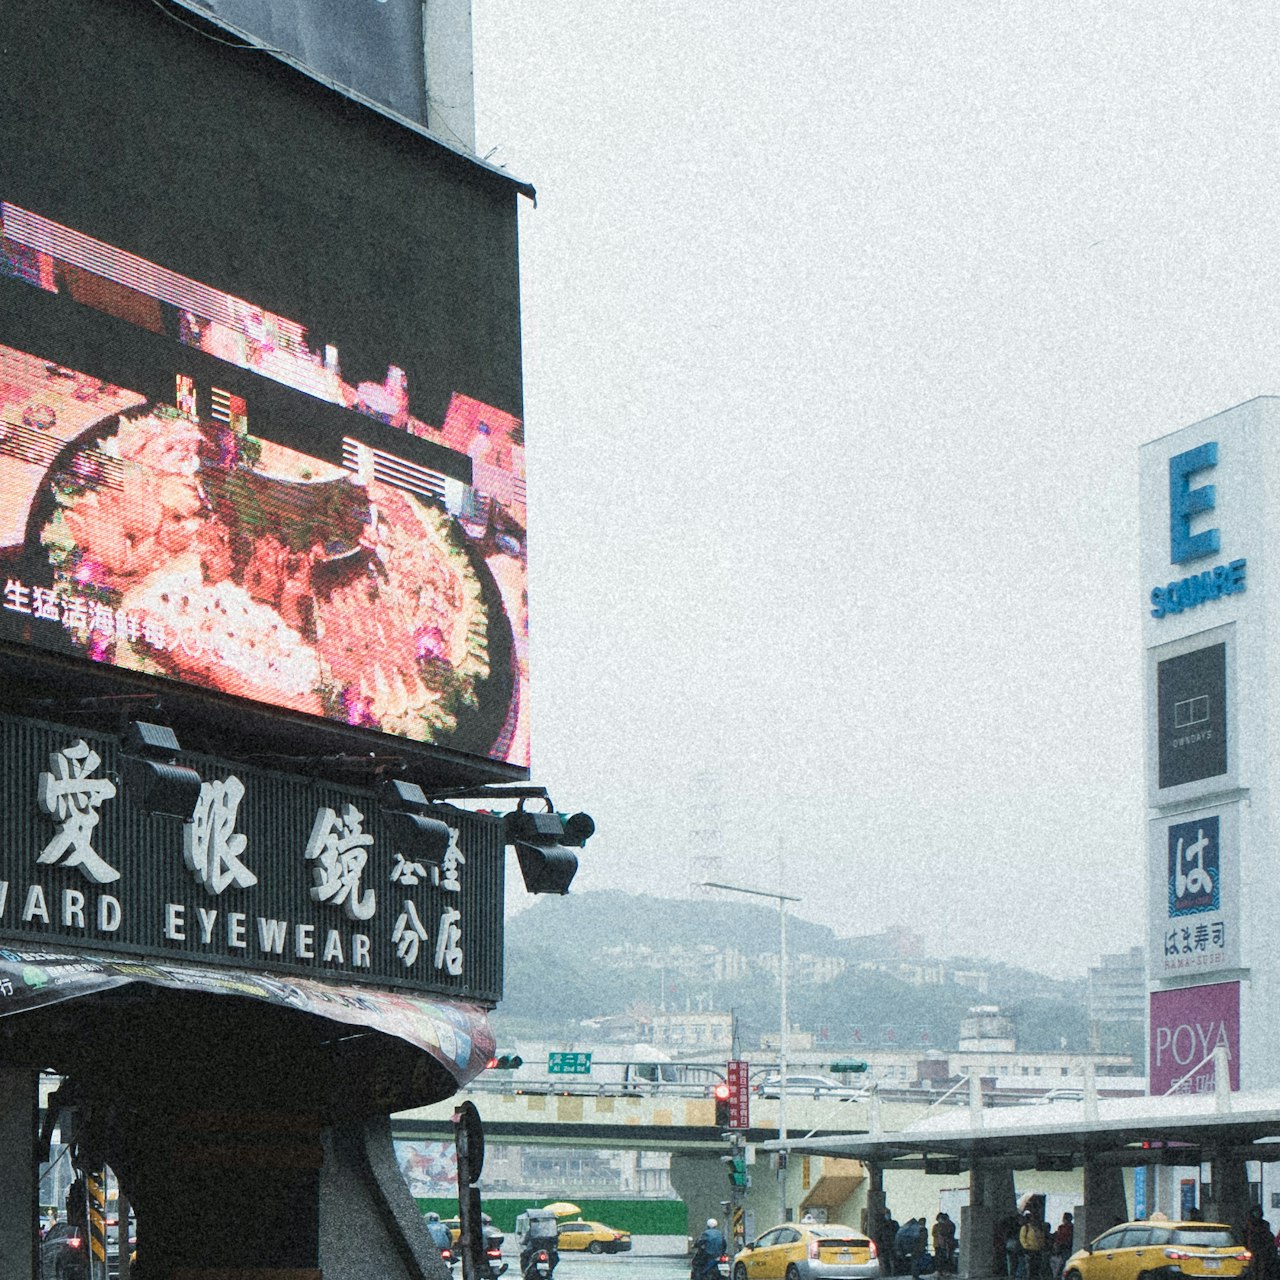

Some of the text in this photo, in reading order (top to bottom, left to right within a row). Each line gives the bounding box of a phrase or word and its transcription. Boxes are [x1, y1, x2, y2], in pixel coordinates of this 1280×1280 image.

[1170, 441, 1220, 565] E
[1151, 558, 1247, 619] SQUARE
[1176, 828, 1213, 898] は
[164, 903, 372, 968] EYEWEAR
[391, 900, 463, 976] 分店
[1164, 921, 1225, 956] はま寿司
[1156, 1020, 1232, 1067] POYA
